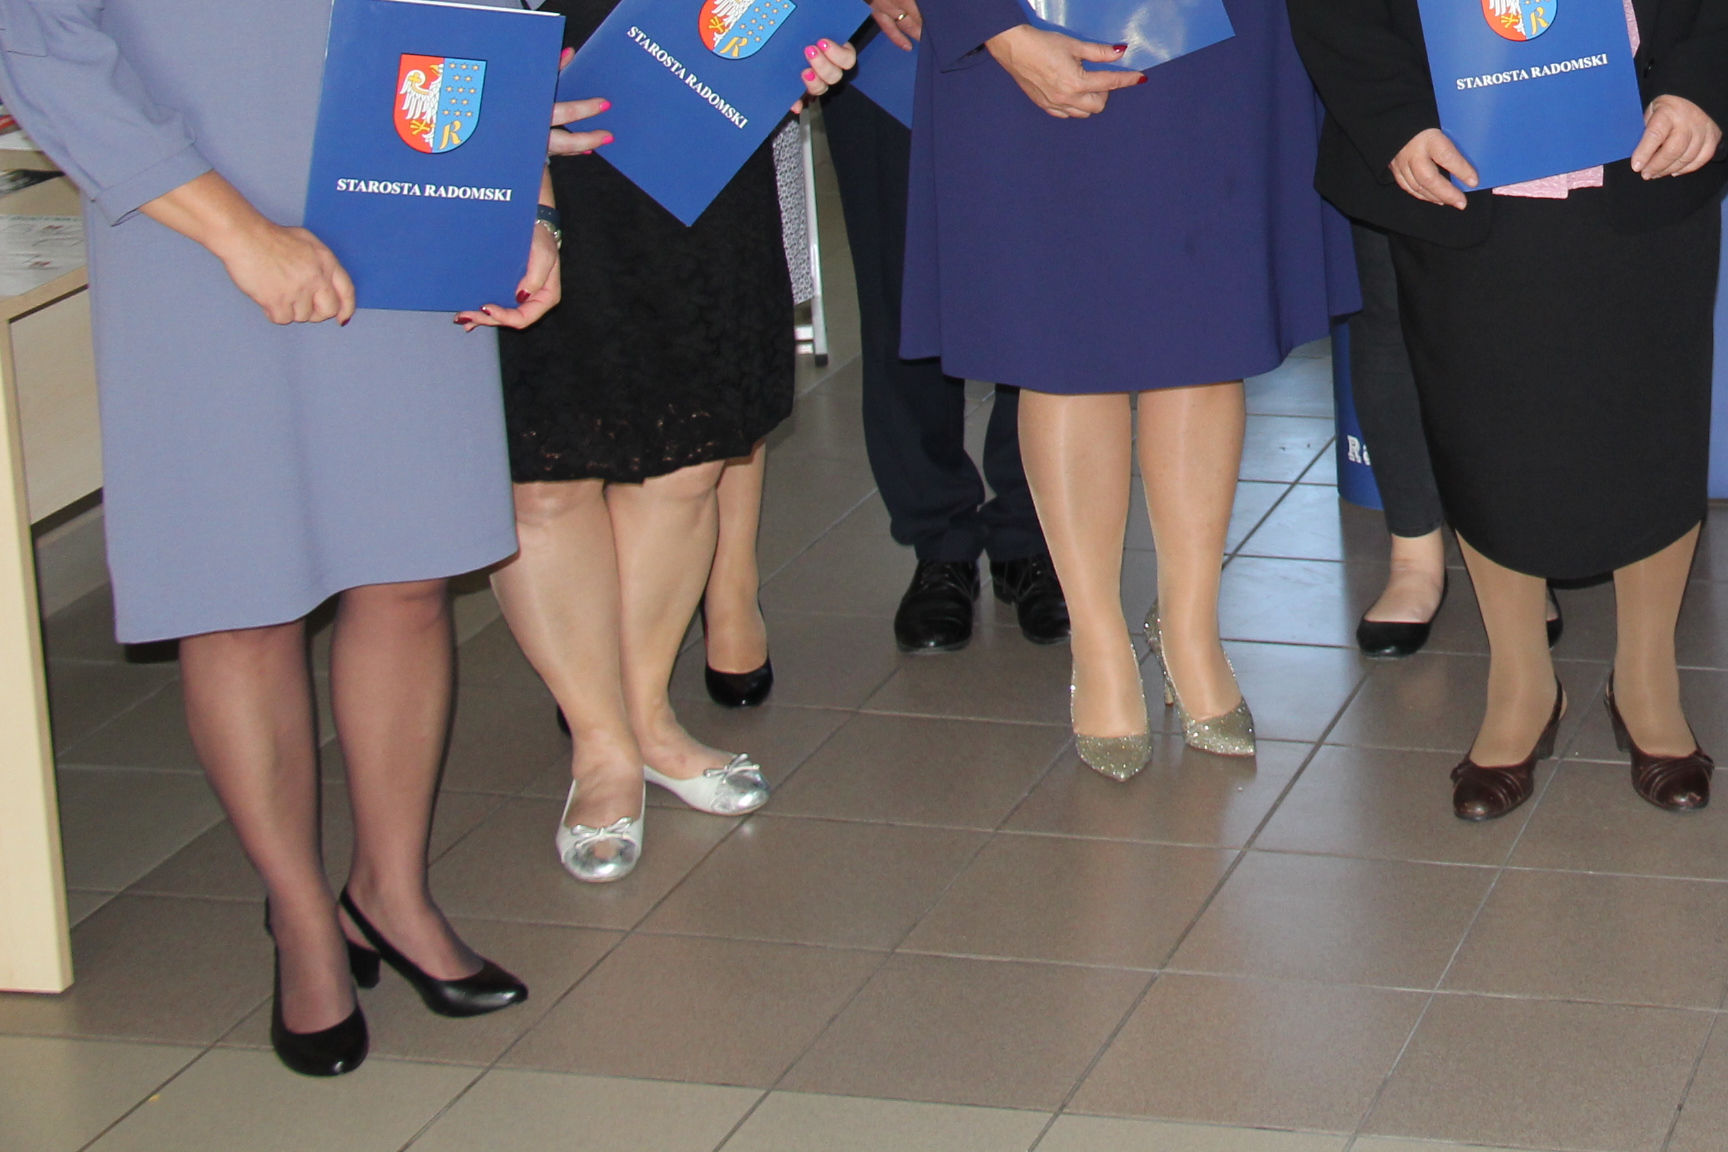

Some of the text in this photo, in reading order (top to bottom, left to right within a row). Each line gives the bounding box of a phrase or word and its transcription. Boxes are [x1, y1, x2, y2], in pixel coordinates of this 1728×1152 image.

[627, 26, 749, 129] STAROSTA RADOMSKI
[1456, 53, 1608, 90] STAROSTA RADOMSKI
[336, 178, 513, 201] STAROSTA RADOMSKI
